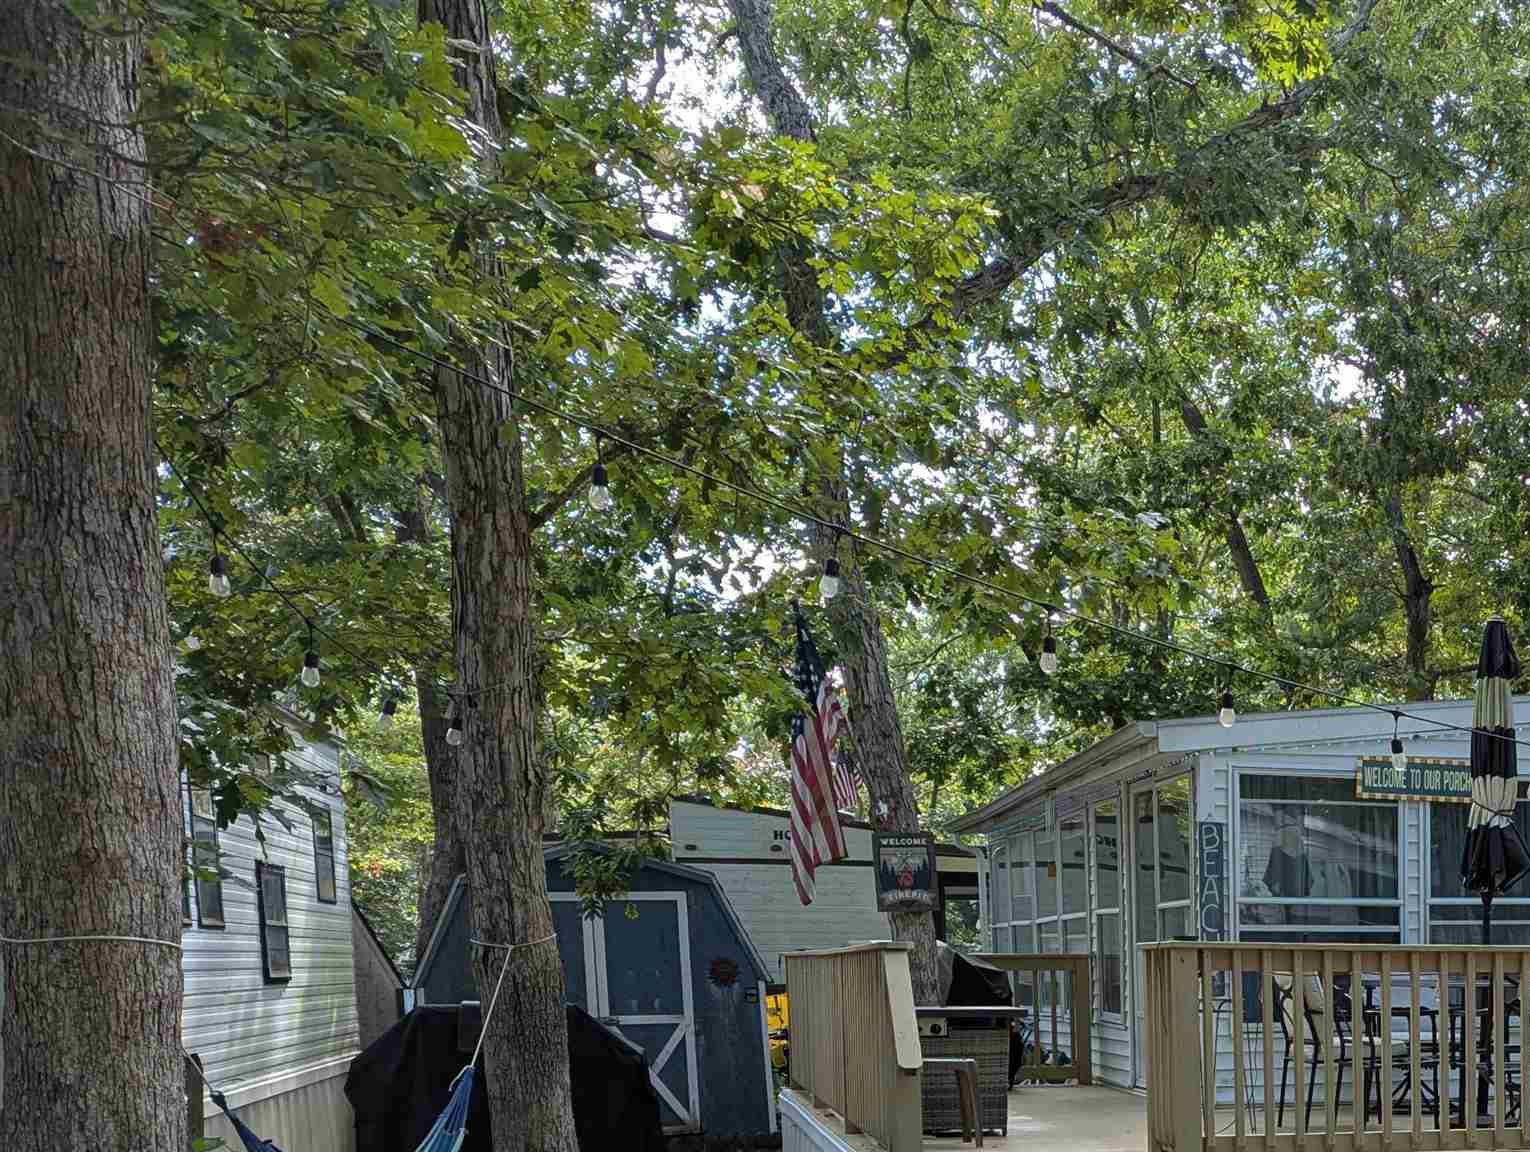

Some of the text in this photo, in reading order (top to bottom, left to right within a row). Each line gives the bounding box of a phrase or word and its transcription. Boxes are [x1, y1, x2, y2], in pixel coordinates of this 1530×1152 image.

[1363, 766, 1407, 788] WELCOME
[1410, 768, 1421, 788] TO
[1423, 769, 1441, 790] OUR
[879, 837, 928, 846] WELCOME
[1202, 824, 1221, 941] BEAC
